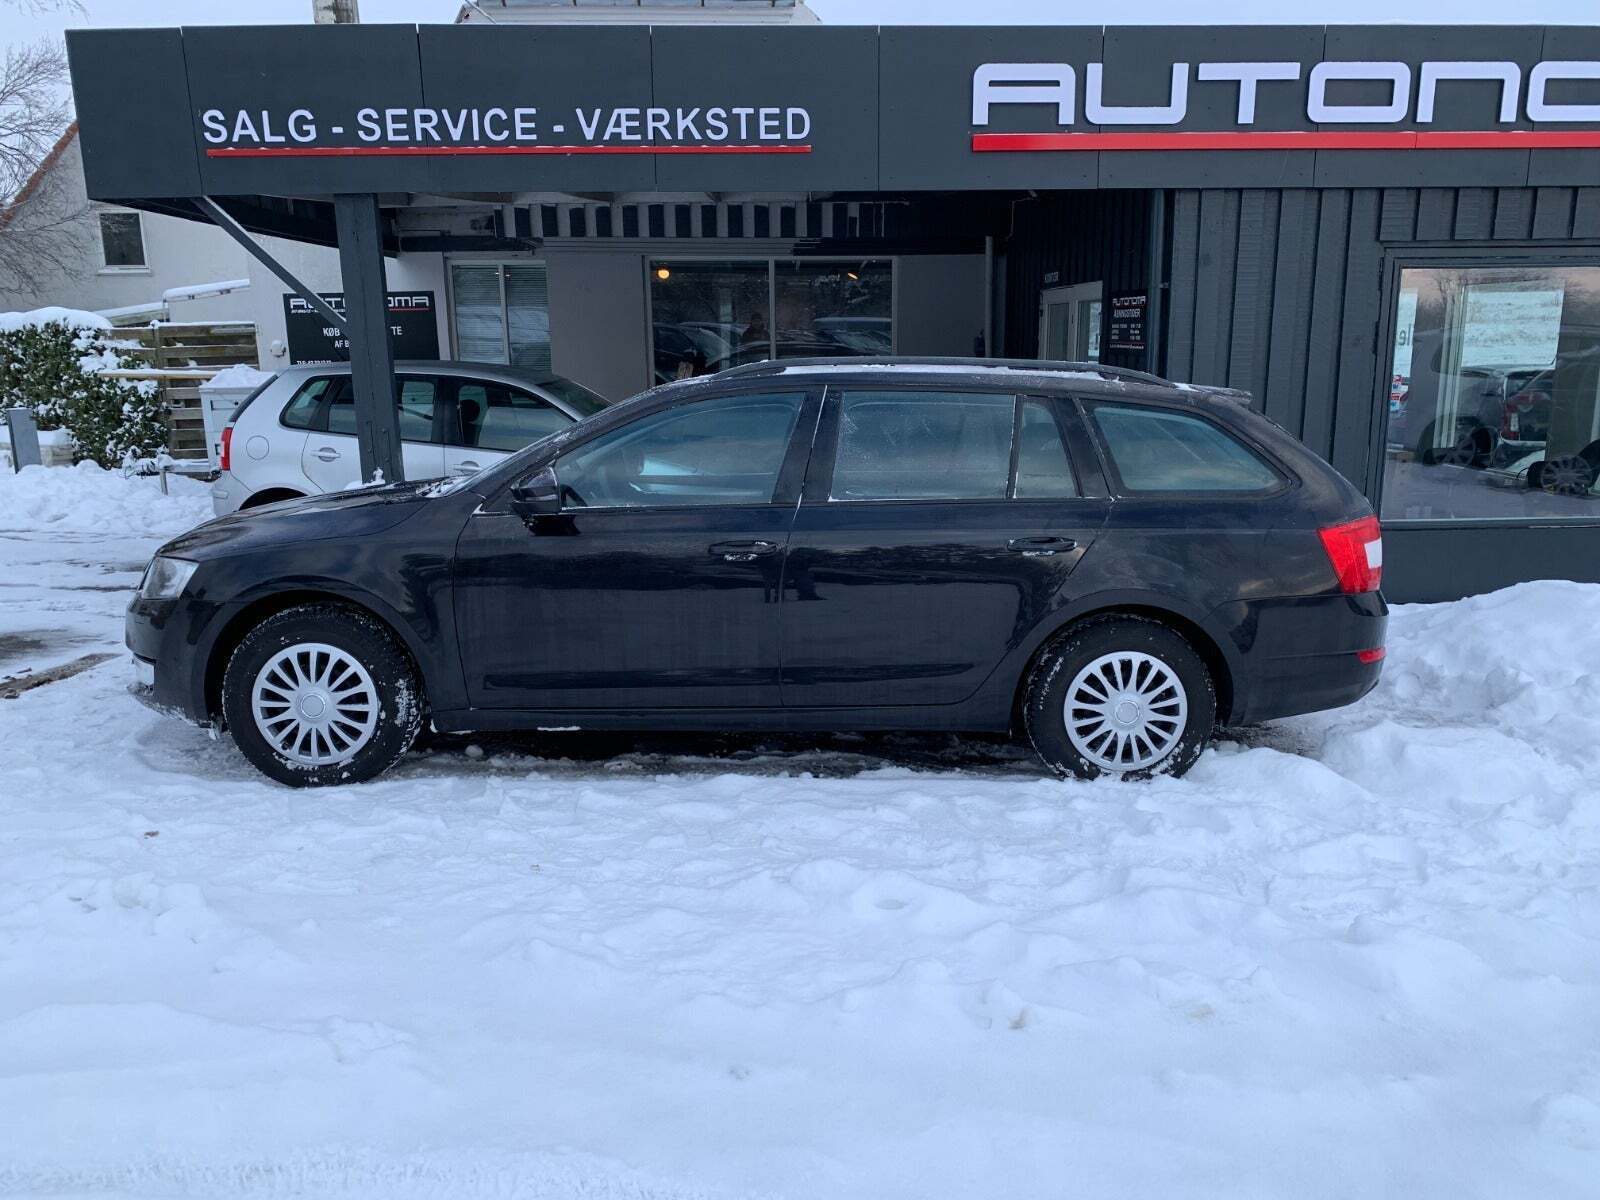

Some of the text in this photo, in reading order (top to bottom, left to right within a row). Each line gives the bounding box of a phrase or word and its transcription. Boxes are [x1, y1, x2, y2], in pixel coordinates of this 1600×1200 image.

[202, 109, 318, 143] SALG
[357, 107, 538, 142] SERVICE
[575, 107, 811, 141] VÆRKSTED
[322, 327, 341, 337] KØB
